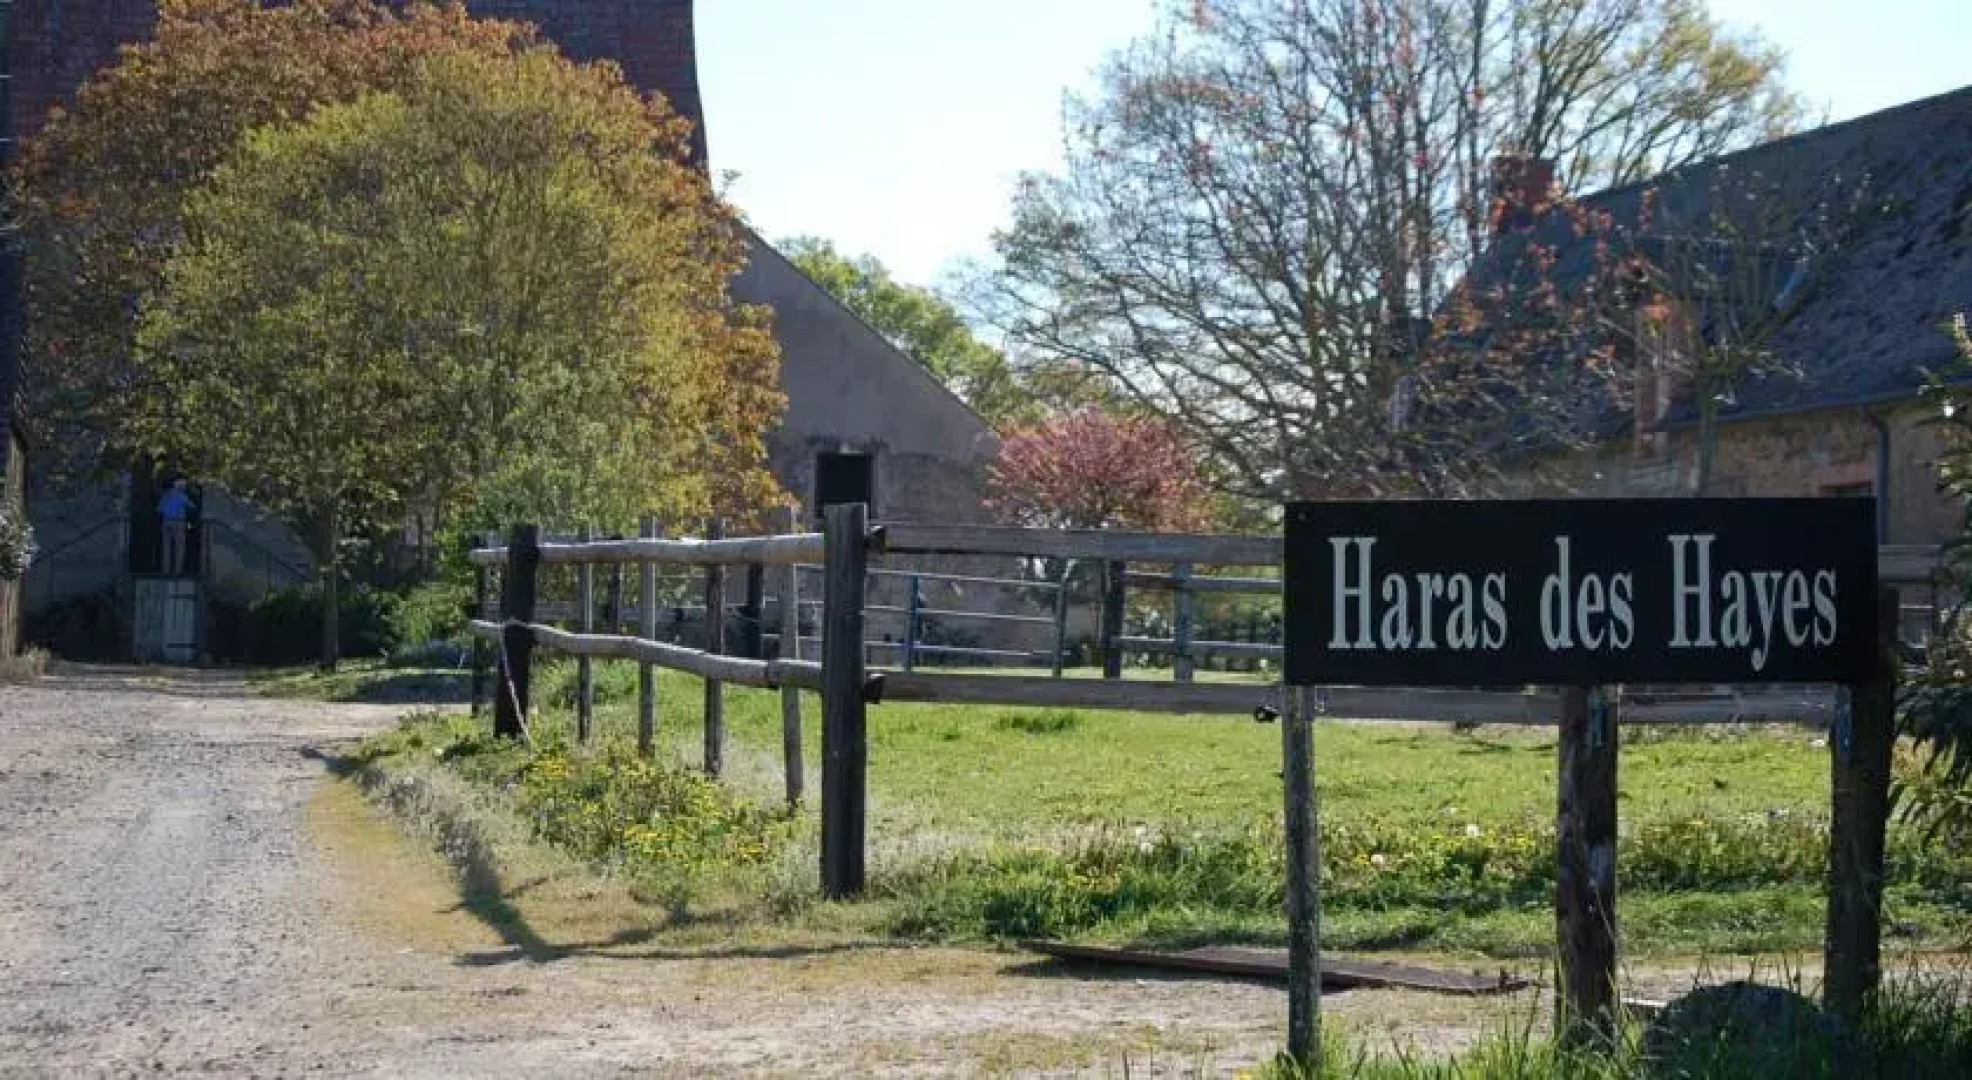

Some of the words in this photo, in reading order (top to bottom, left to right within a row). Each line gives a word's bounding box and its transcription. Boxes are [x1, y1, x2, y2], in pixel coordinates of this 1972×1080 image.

[1328, 536, 1507, 650] Haras
[1540, 536, 1634, 650] des
[1667, 533, 1837, 671] Hayes
